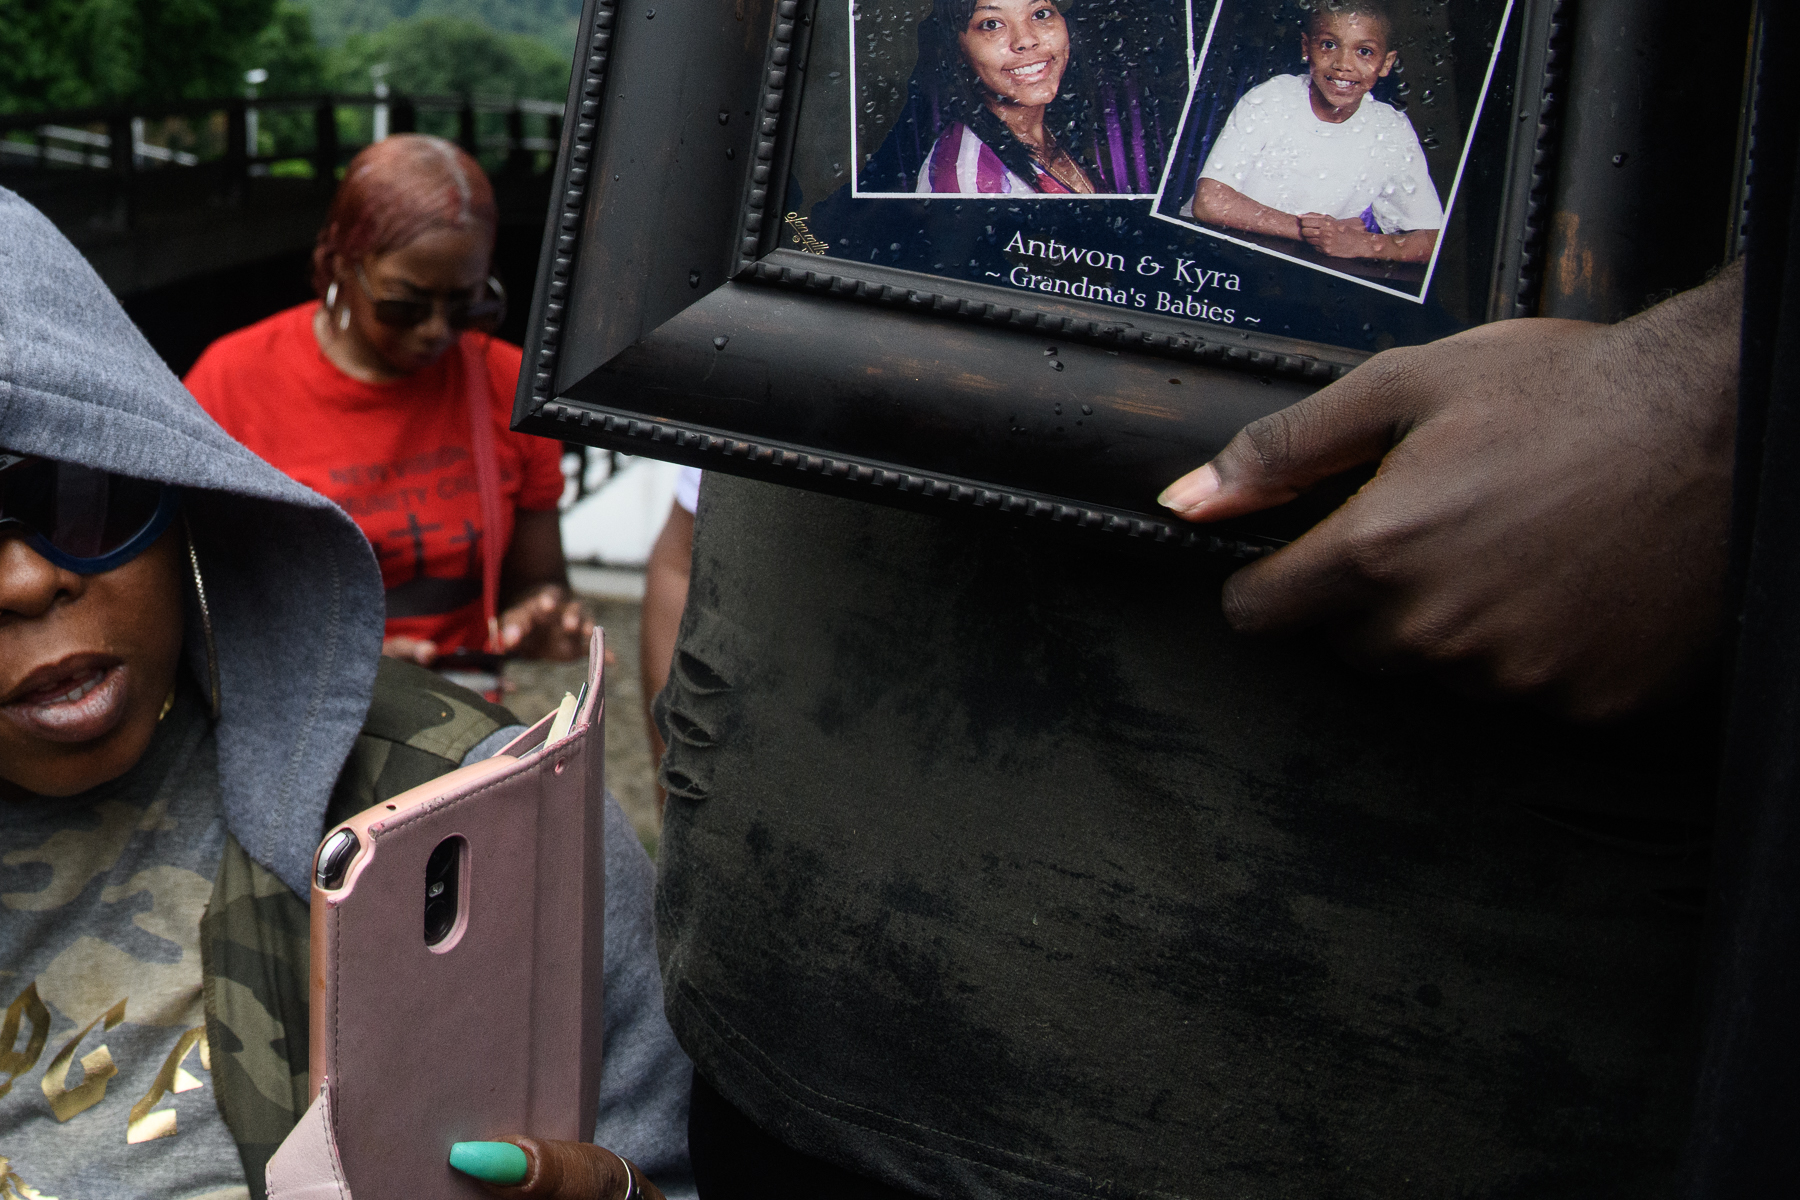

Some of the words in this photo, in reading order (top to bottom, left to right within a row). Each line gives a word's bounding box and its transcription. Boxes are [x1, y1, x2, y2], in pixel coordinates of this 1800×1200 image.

[1003, 230, 1126, 273] Antwon
[1136, 255, 1165, 277] &
[1173, 257, 1242, 293] Kyra
[1009, 266, 1146, 308] Grandma's
[1154, 290, 1236, 324] Babies
